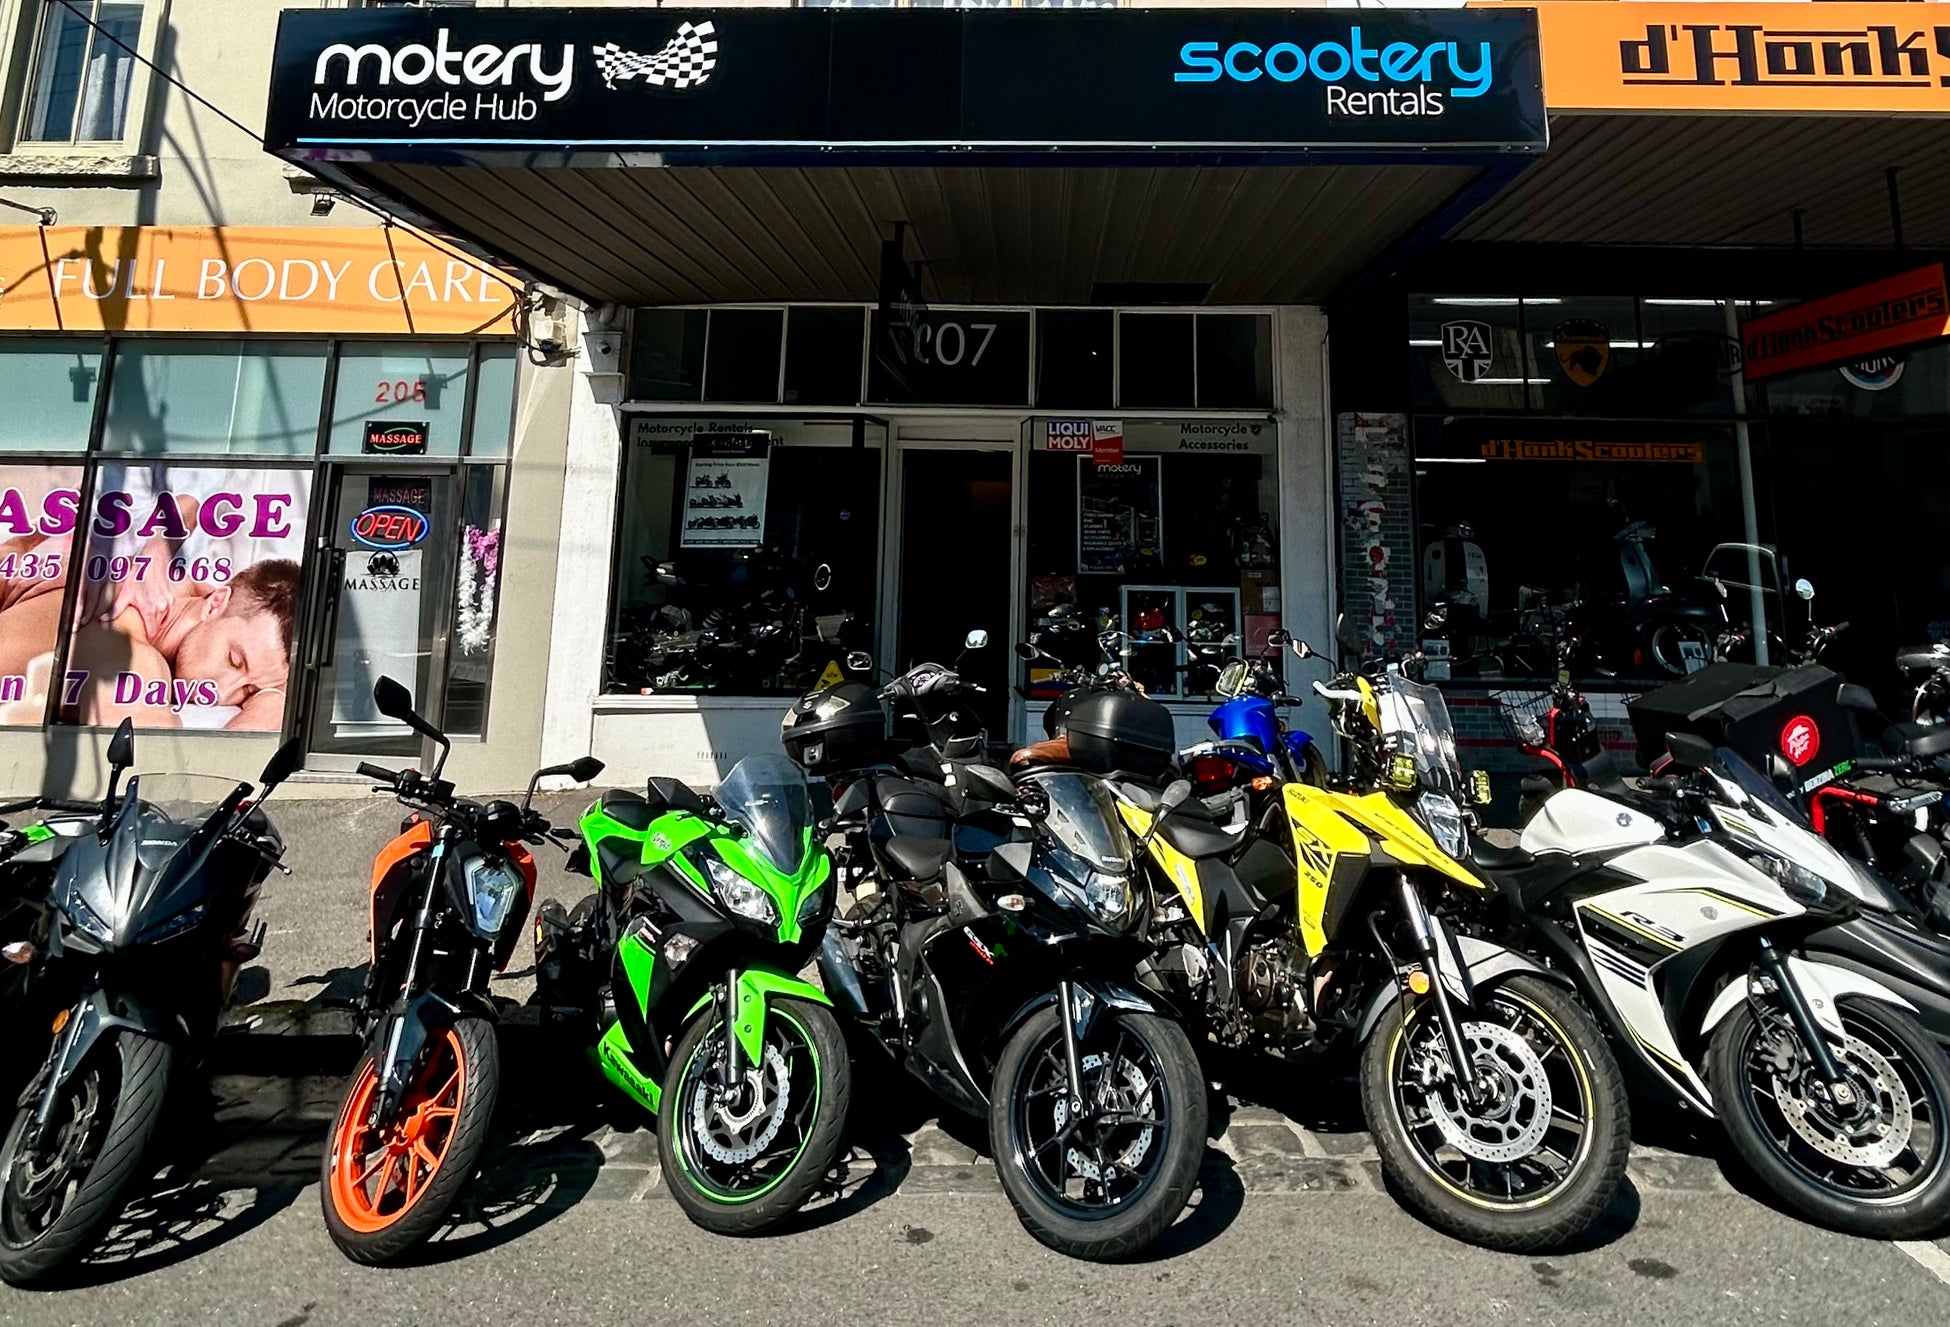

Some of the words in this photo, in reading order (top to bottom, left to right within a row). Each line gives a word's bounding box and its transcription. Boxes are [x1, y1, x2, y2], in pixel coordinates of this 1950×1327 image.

[314, 28, 575, 102] motery
[1173, 26, 1493, 98] scootery
[309, 91, 467, 129] Motorcycle
[474, 91, 538, 122] Hub
[1326, 84, 1444, 117] Rentals
[54, 258, 179, 300] FULL
[197, 258, 352, 302] BODY
[369, 259, 502, 304] CARE
[375, 380, 427, 403] 205
[369, 433, 423, 445] MASSAGE
[637, 422, 704, 437] Motorcycle
[708, 422, 753, 434] Rentals
[1048, 421, 1090, 436] LIQUI
[1180, 422, 1248, 437] Motorcycle
[1048, 436, 1091, 450] MOLY
[1179, 438, 1249, 451] Accessories
[1097, 462, 1142, 476] motery
[373, 487, 425, 505] MASSAGE
[356, 513, 422, 542] OPEN
[86, 554, 152, 582] 097
[167, 555, 233, 583] 668
[344, 577, 420, 591] MASSAGE
[64, 670, 90, 704] 7
[114, 670, 219, 711] Days
[1287, 788, 1311, 805] SUZUKI
[1303, 870, 1324, 888] 250
[1619, 910, 1687, 942] R3
[963, 925, 996, 959] GSX
[603, 1040, 655, 1107] Kawasaki
